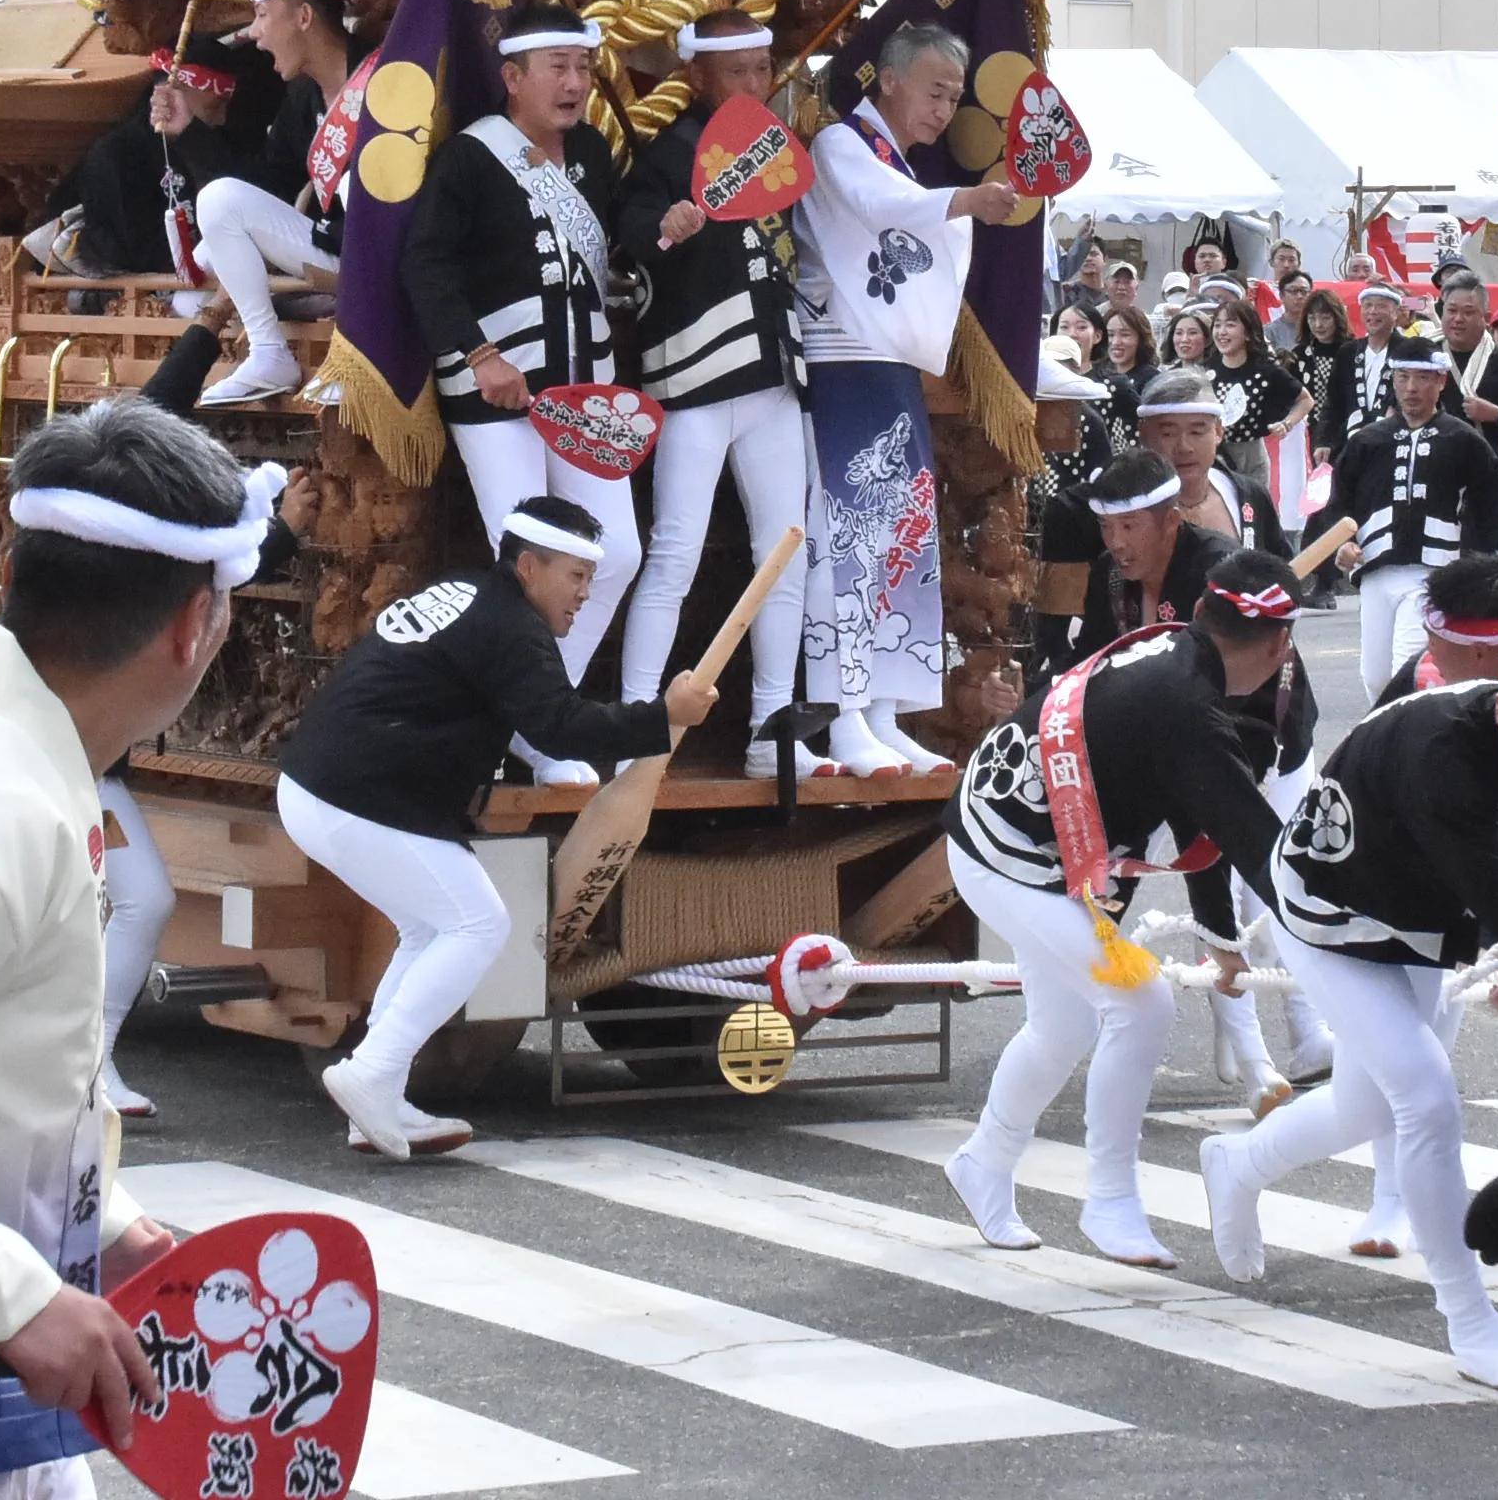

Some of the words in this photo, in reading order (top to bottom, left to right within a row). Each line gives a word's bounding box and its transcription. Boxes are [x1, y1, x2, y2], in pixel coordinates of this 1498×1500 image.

[1043, 670, 1083, 790] 青年団
[130, 1310, 343, 1436] 会長
[200, 1431, 344, 1500] 若頭
